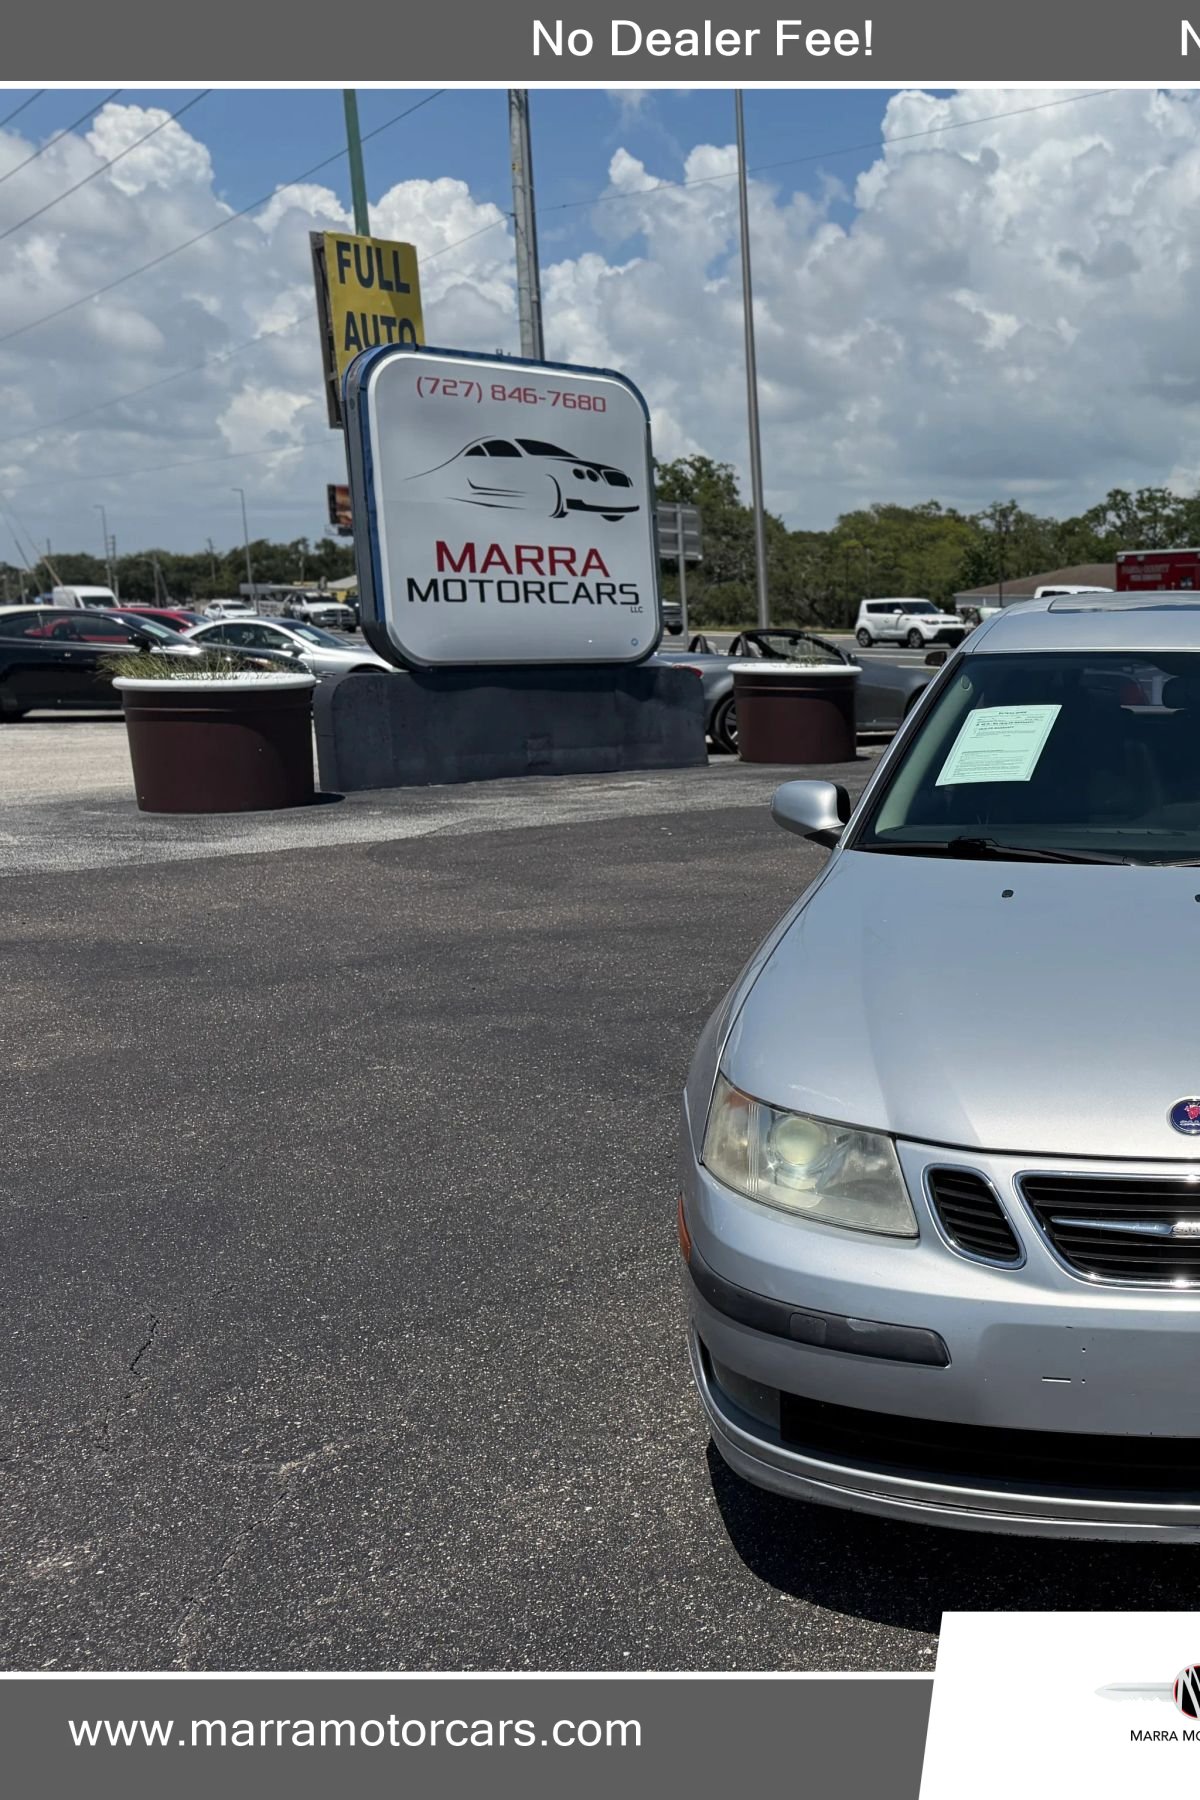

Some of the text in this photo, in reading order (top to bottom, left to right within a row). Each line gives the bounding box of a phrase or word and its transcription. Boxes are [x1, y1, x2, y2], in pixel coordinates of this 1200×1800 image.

[336, 240, 411, 294] FULL
[344, 310, 417, 352] AUTO
[416, 376, 607, 413] (727) 846-7680
[435, 540, 610, 578] MARRA
[406, 576, 640, 606] MOTORCARS
[629, 605, 644, 614] LLC
